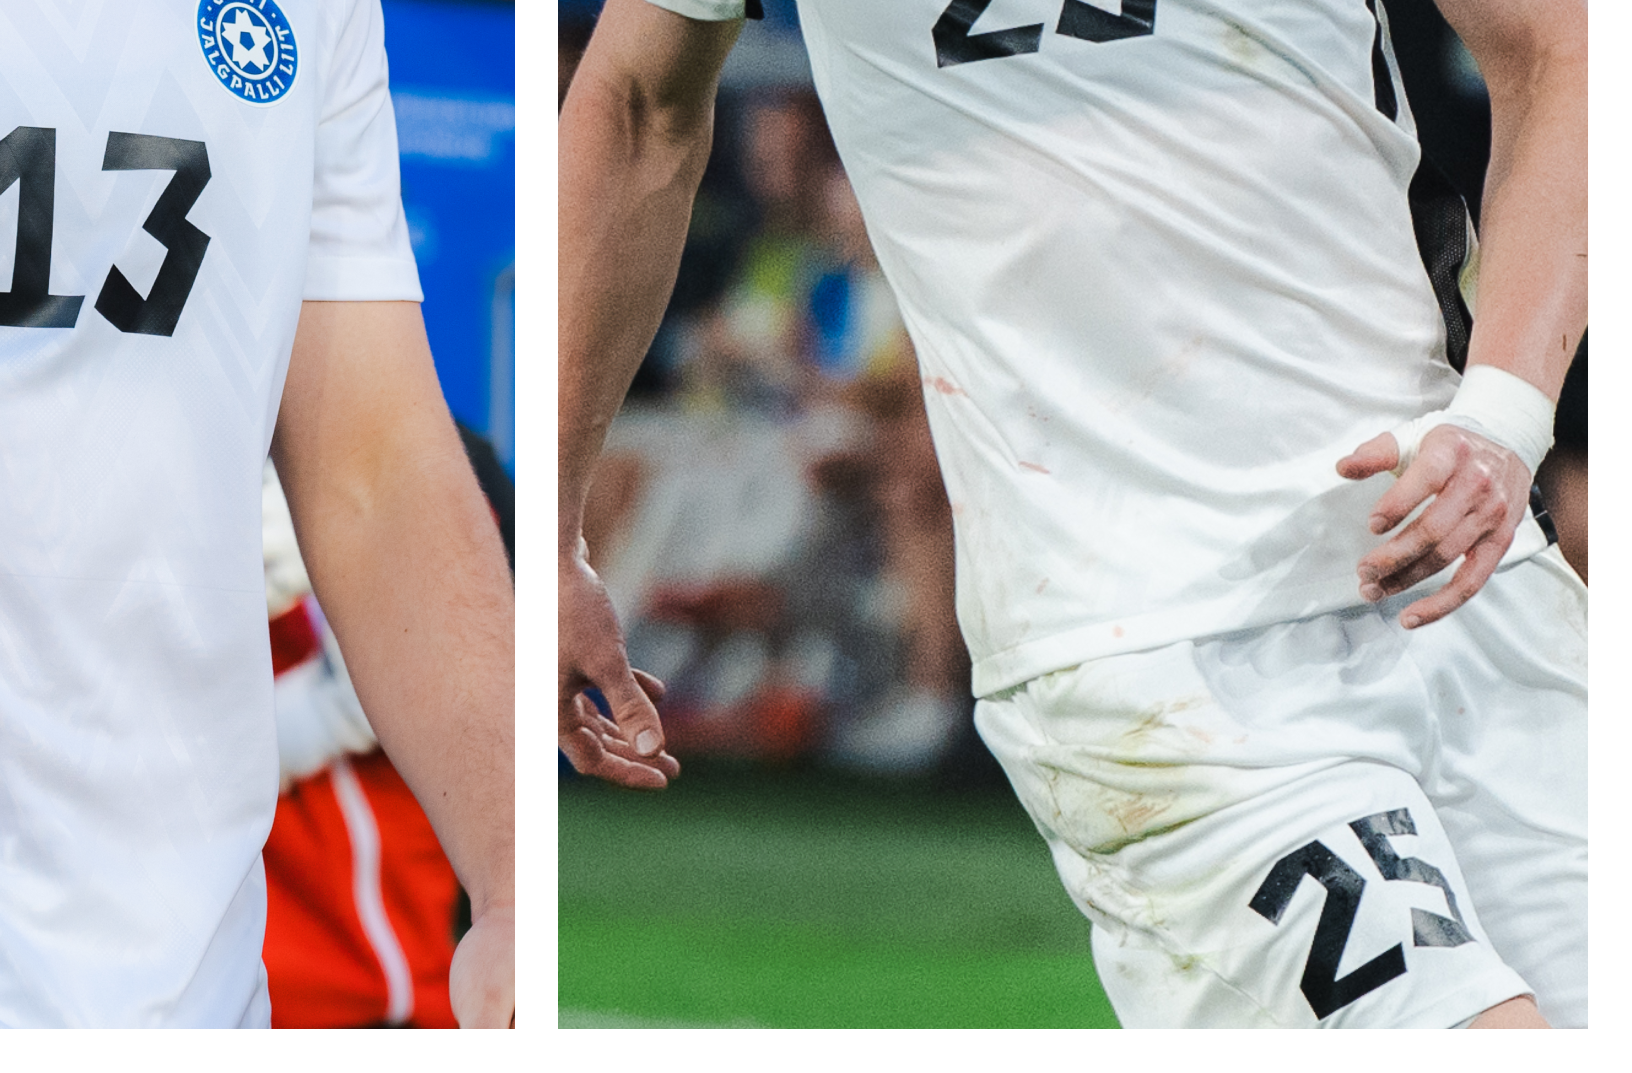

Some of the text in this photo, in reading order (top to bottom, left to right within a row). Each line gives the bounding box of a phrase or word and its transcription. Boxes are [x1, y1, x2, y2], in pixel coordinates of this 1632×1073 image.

[200, 17, 295, 100] JALGPALLI LIIT
[1248, 807, 1478, 1021] 25
